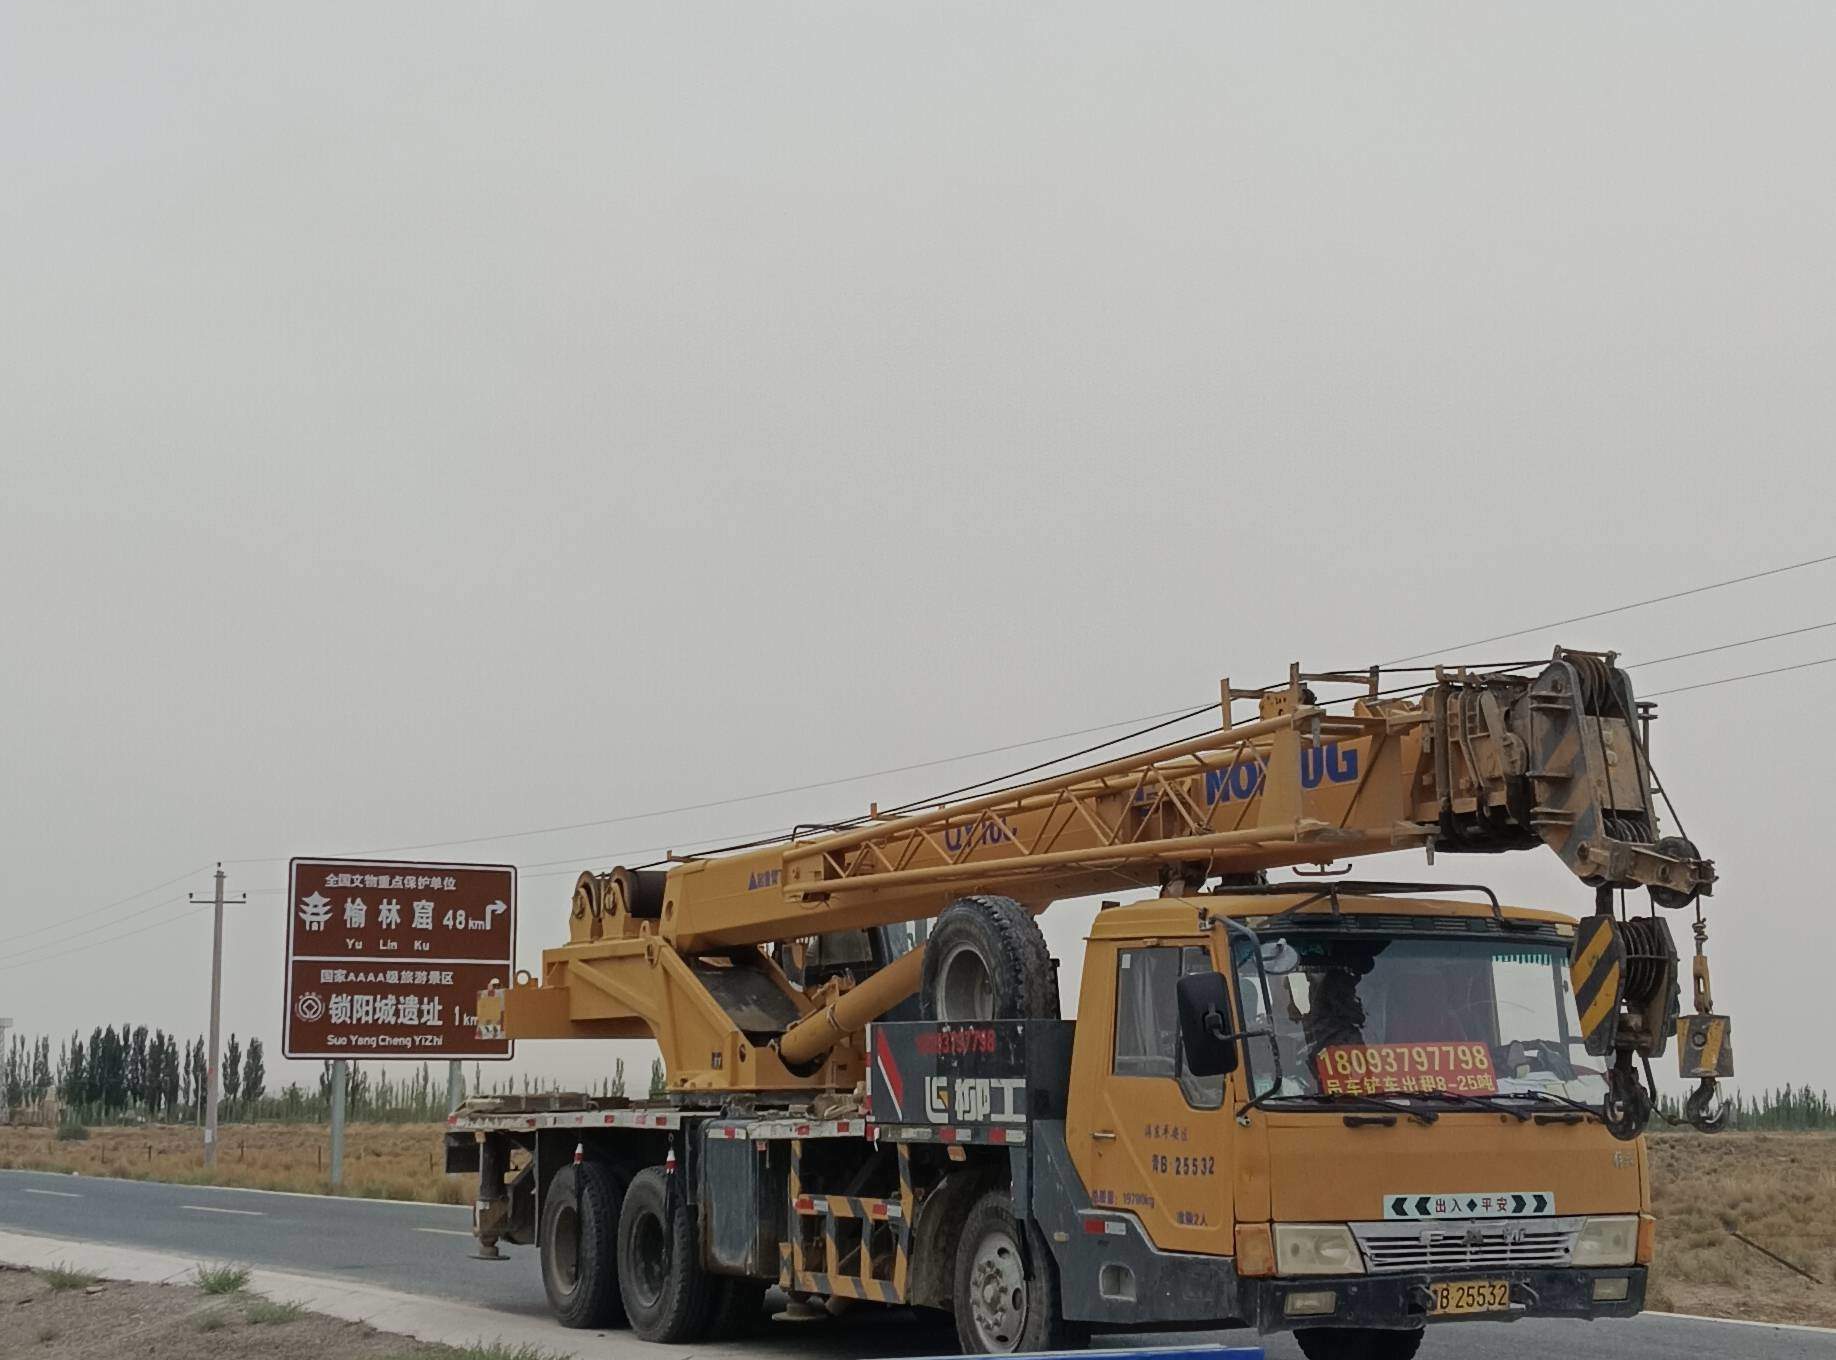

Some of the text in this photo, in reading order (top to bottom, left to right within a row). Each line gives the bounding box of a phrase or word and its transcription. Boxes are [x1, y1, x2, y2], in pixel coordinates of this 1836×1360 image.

[325, 873, 457, 891] 全国文物重点保护单位
[344, 897, 434, 931] 榆林窟
[346, 939, 430, 951] Yu Lin Ku
[320, 969, 454, 985] 国家AAAA级旅游景区
[329, 993, 443, 1026] 锁阳城遗址
[327, 1034, 348, 1046] Suo
[350, 1035, 377, 1048] Yang
[378, 1035, 412, 1049] Cheng
[1319, 1045, 1489, 1076] 18093797798
[955, 1077, 1027, 1123] 柳工
